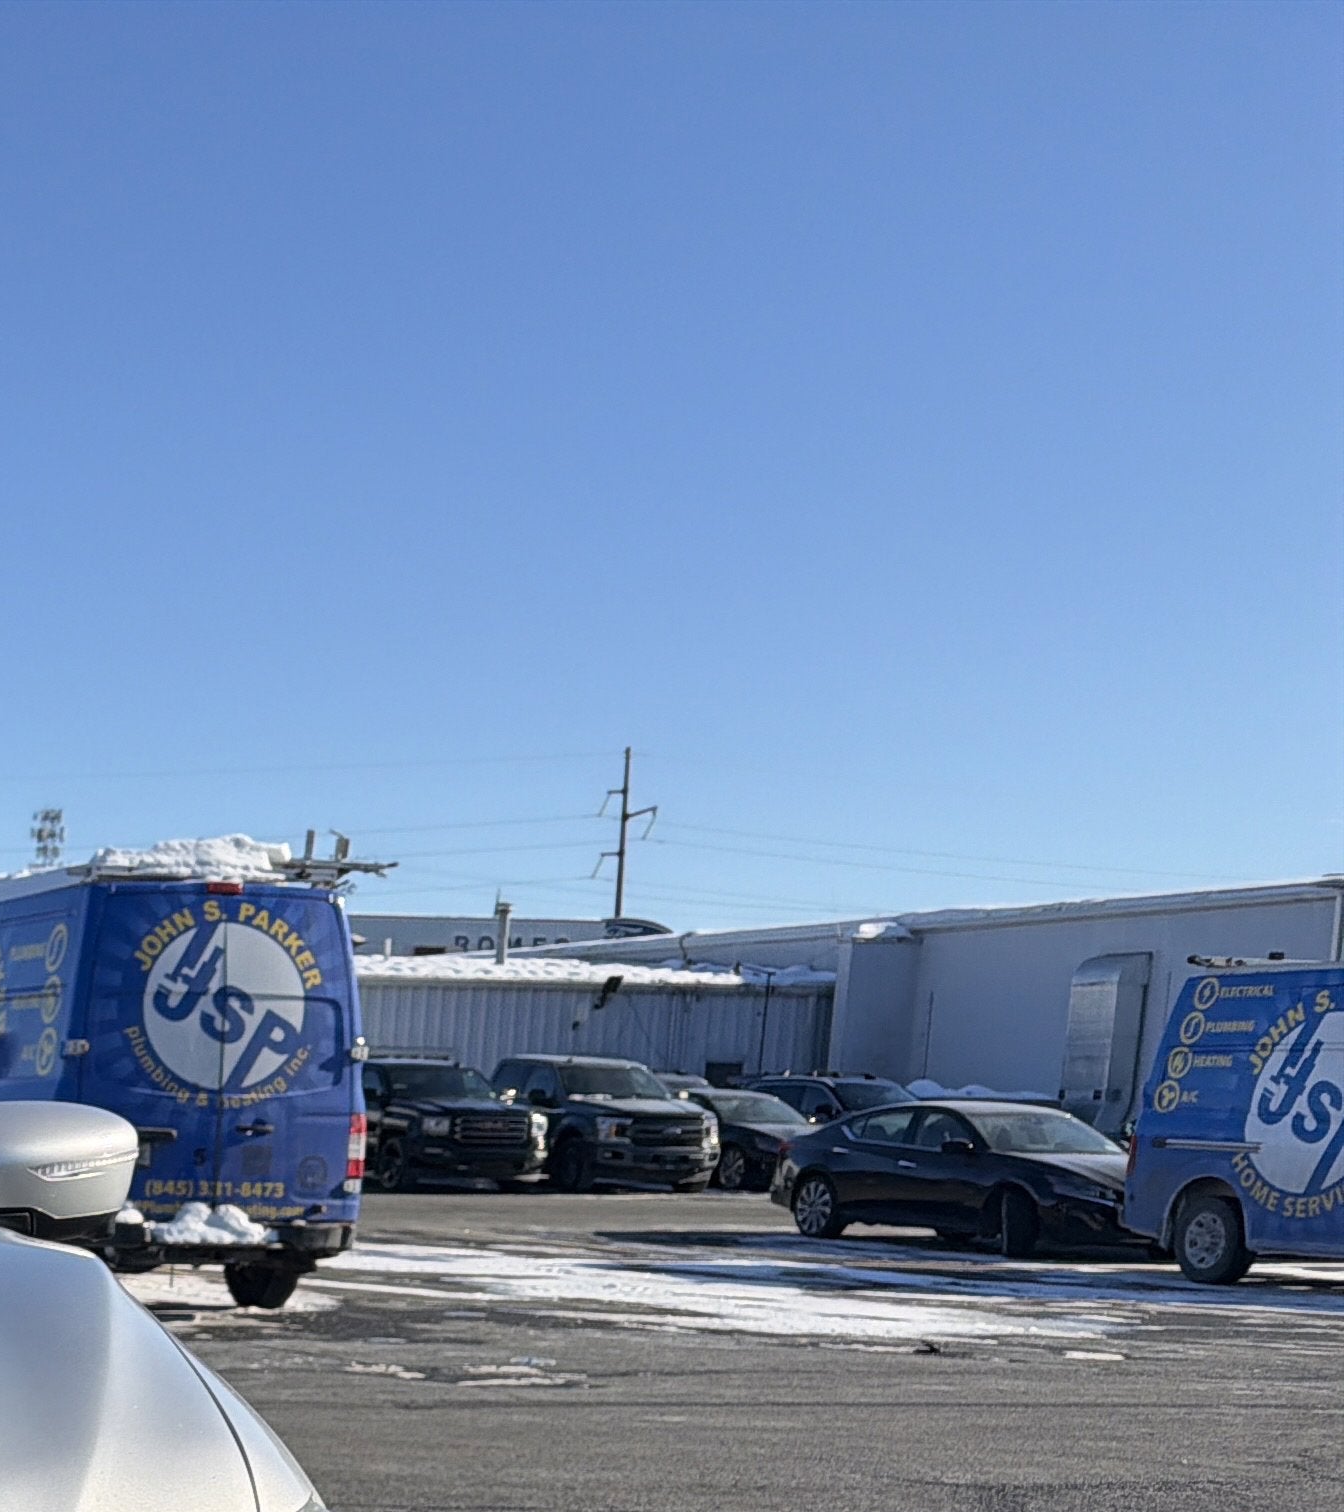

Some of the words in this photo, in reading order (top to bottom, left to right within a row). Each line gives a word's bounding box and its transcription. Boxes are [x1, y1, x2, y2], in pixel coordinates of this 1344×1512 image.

[134, 907, 196, 971] JOHN
[203, 899, 227, 922] S.
[238, 903, 322, 989] PARKER
[153, 920, 304, 1090] JSP
[1249, 1001, 1305, 1076] JOHN
[1314, 989, 1336, 1013] S.
[124, 1025, 191, 1105] plumbing
[1232, 1153, 1280, 1212] HOME
[1283, 1184, 1344, 1218] SERVI
